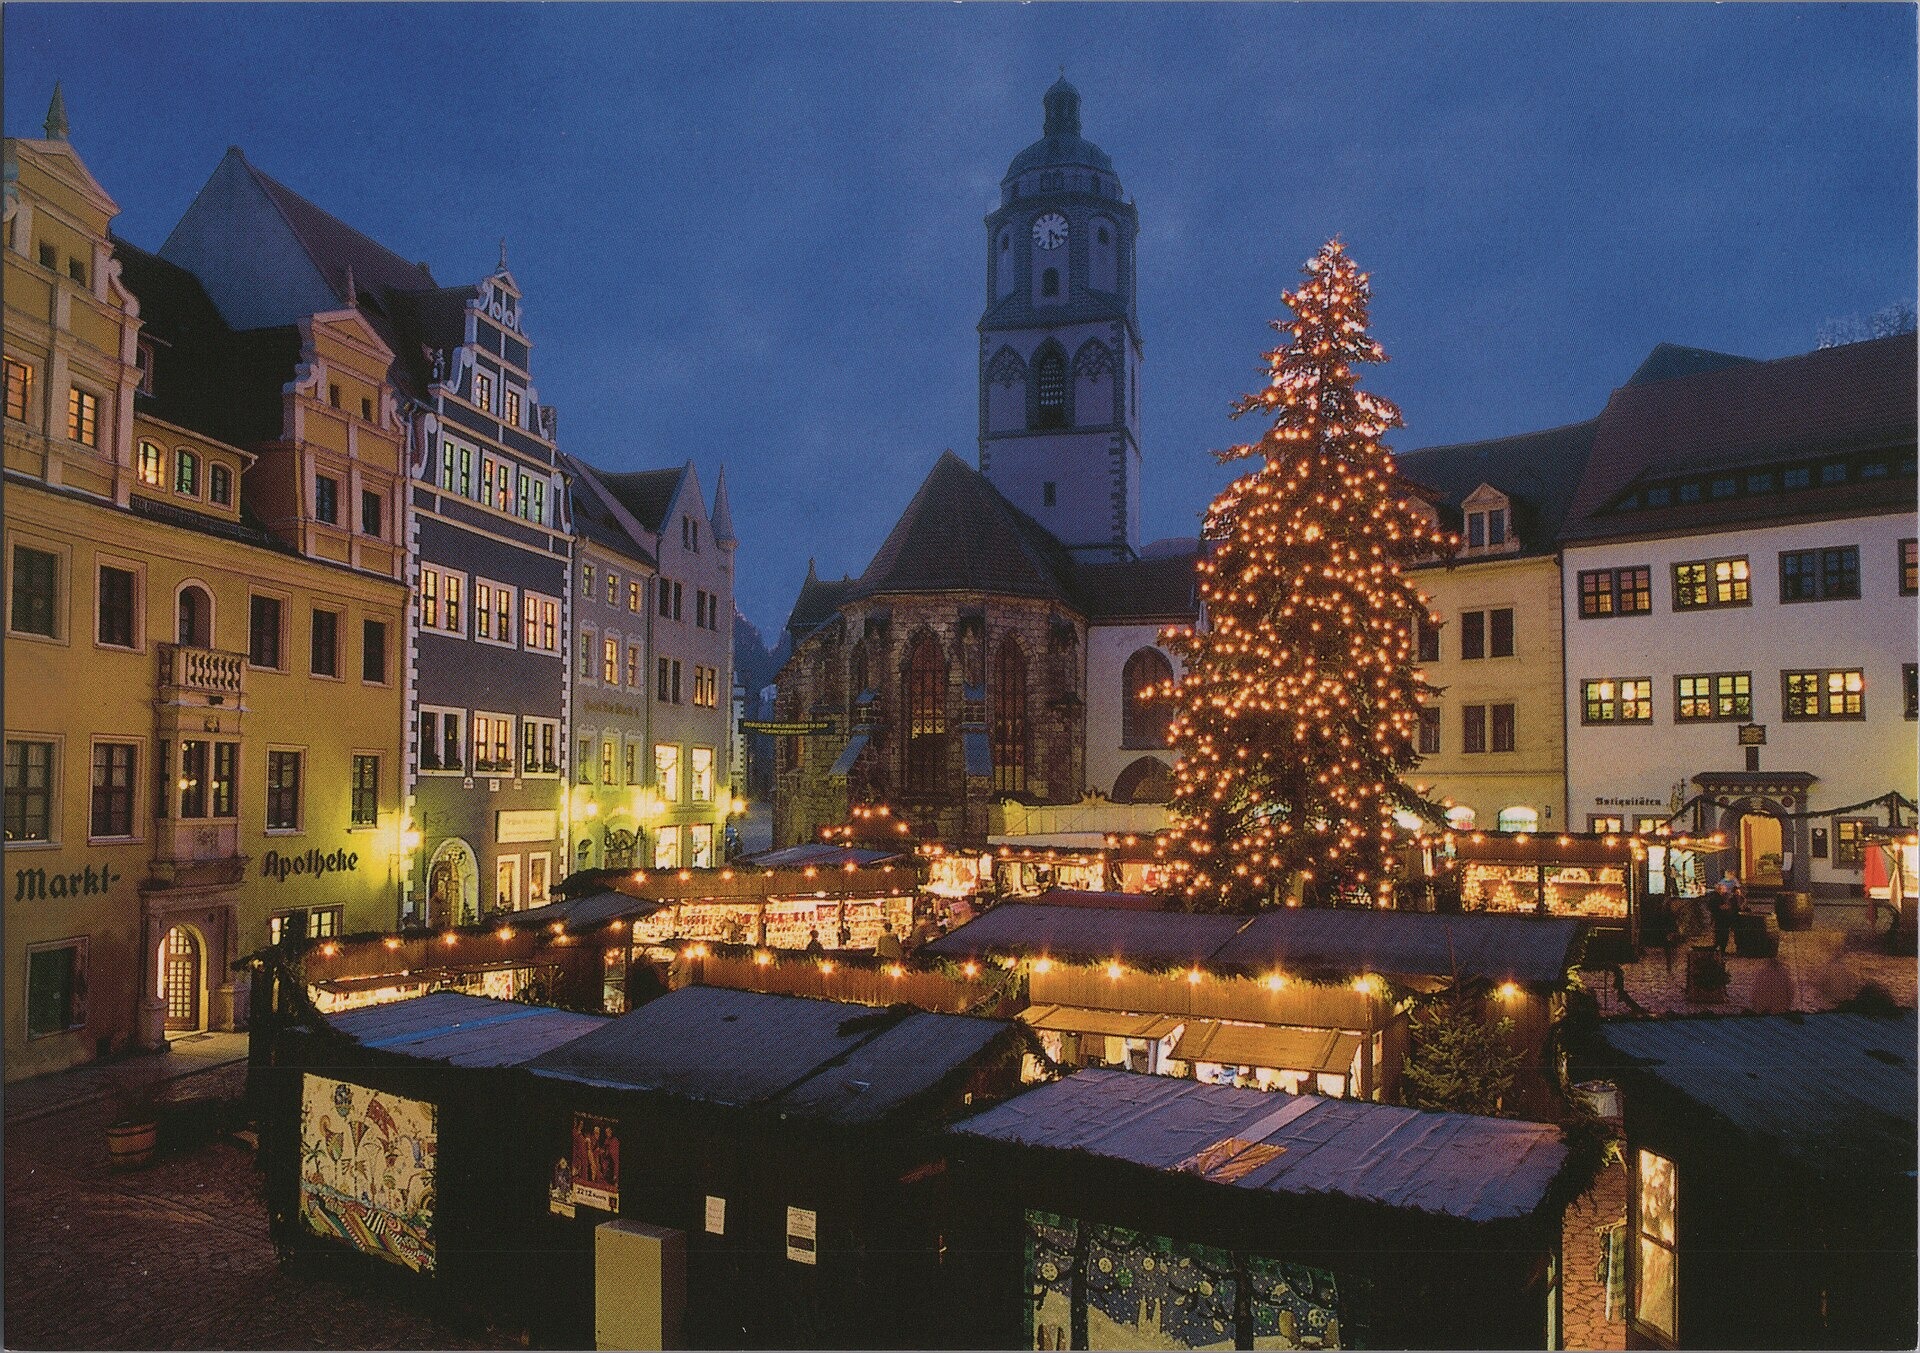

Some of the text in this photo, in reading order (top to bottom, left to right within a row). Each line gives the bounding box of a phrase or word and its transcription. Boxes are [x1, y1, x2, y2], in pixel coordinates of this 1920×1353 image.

[1595, 796, 1661, 807] Antiquitäten
[14, 847, 359, 902] Markt- Apotheke
